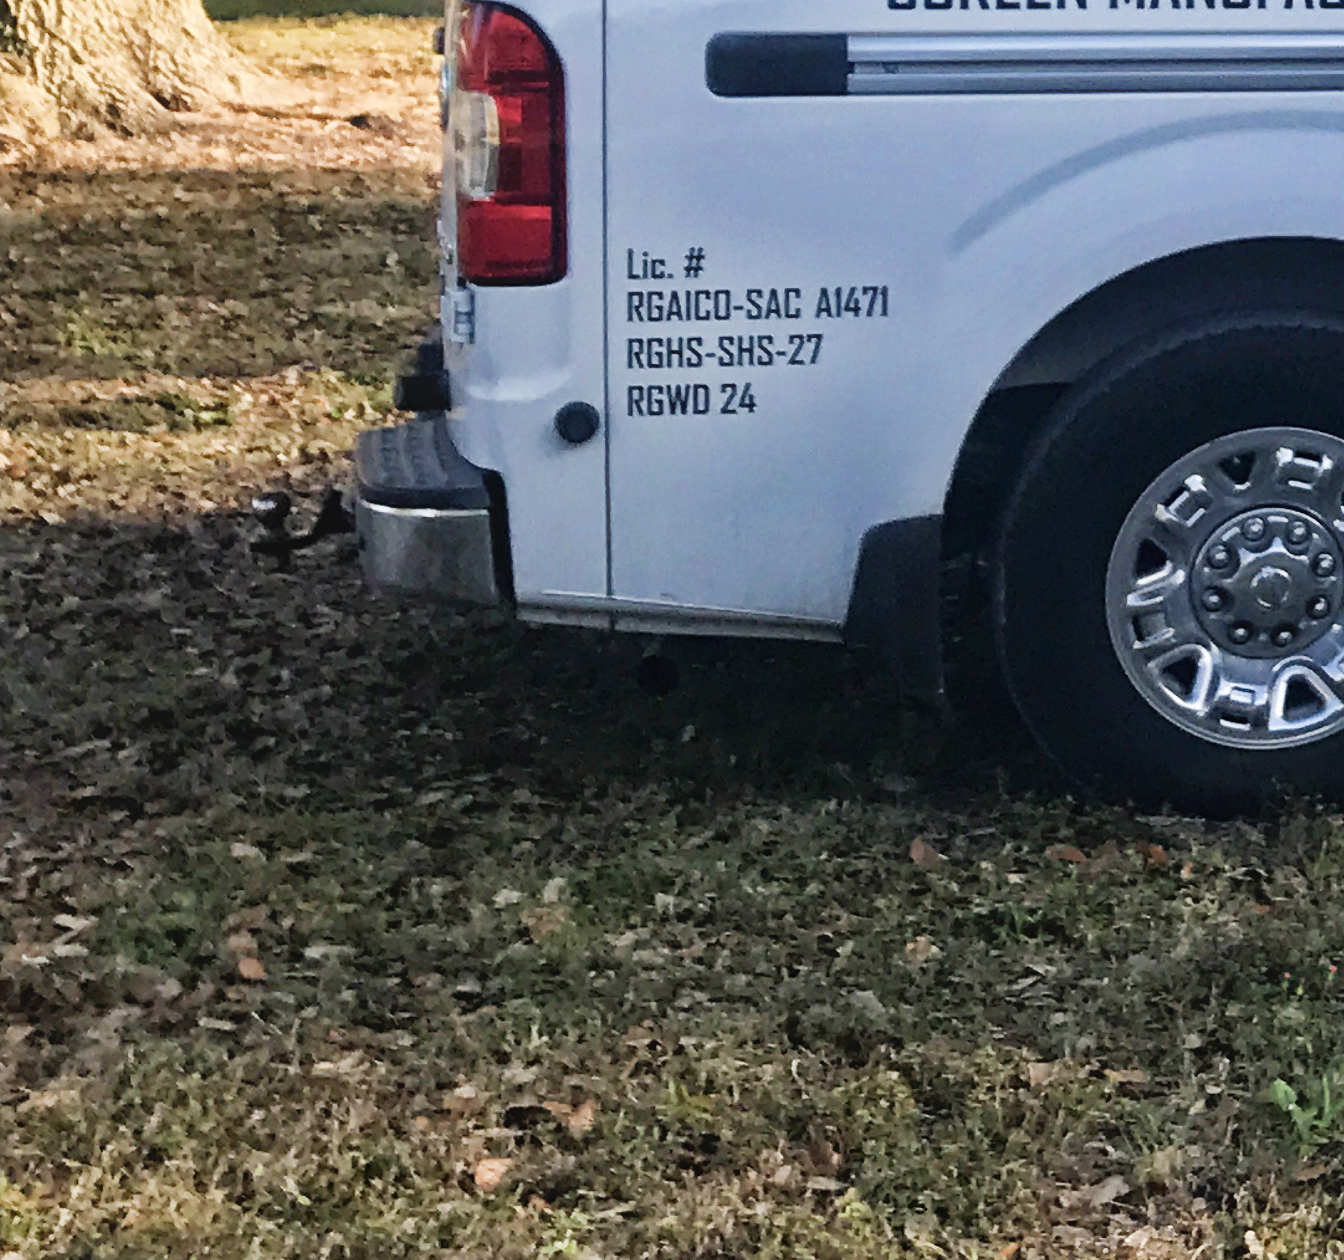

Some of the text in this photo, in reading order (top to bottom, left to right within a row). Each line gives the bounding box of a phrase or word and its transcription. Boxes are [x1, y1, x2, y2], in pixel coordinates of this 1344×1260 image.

[626, 247, 705, 280] Lic. #
[814, 285, 888, 319] A1471
[626, 333, 824, 369] RGHS-SHS-27
[626, 382, 757, 417] RGWD 24
